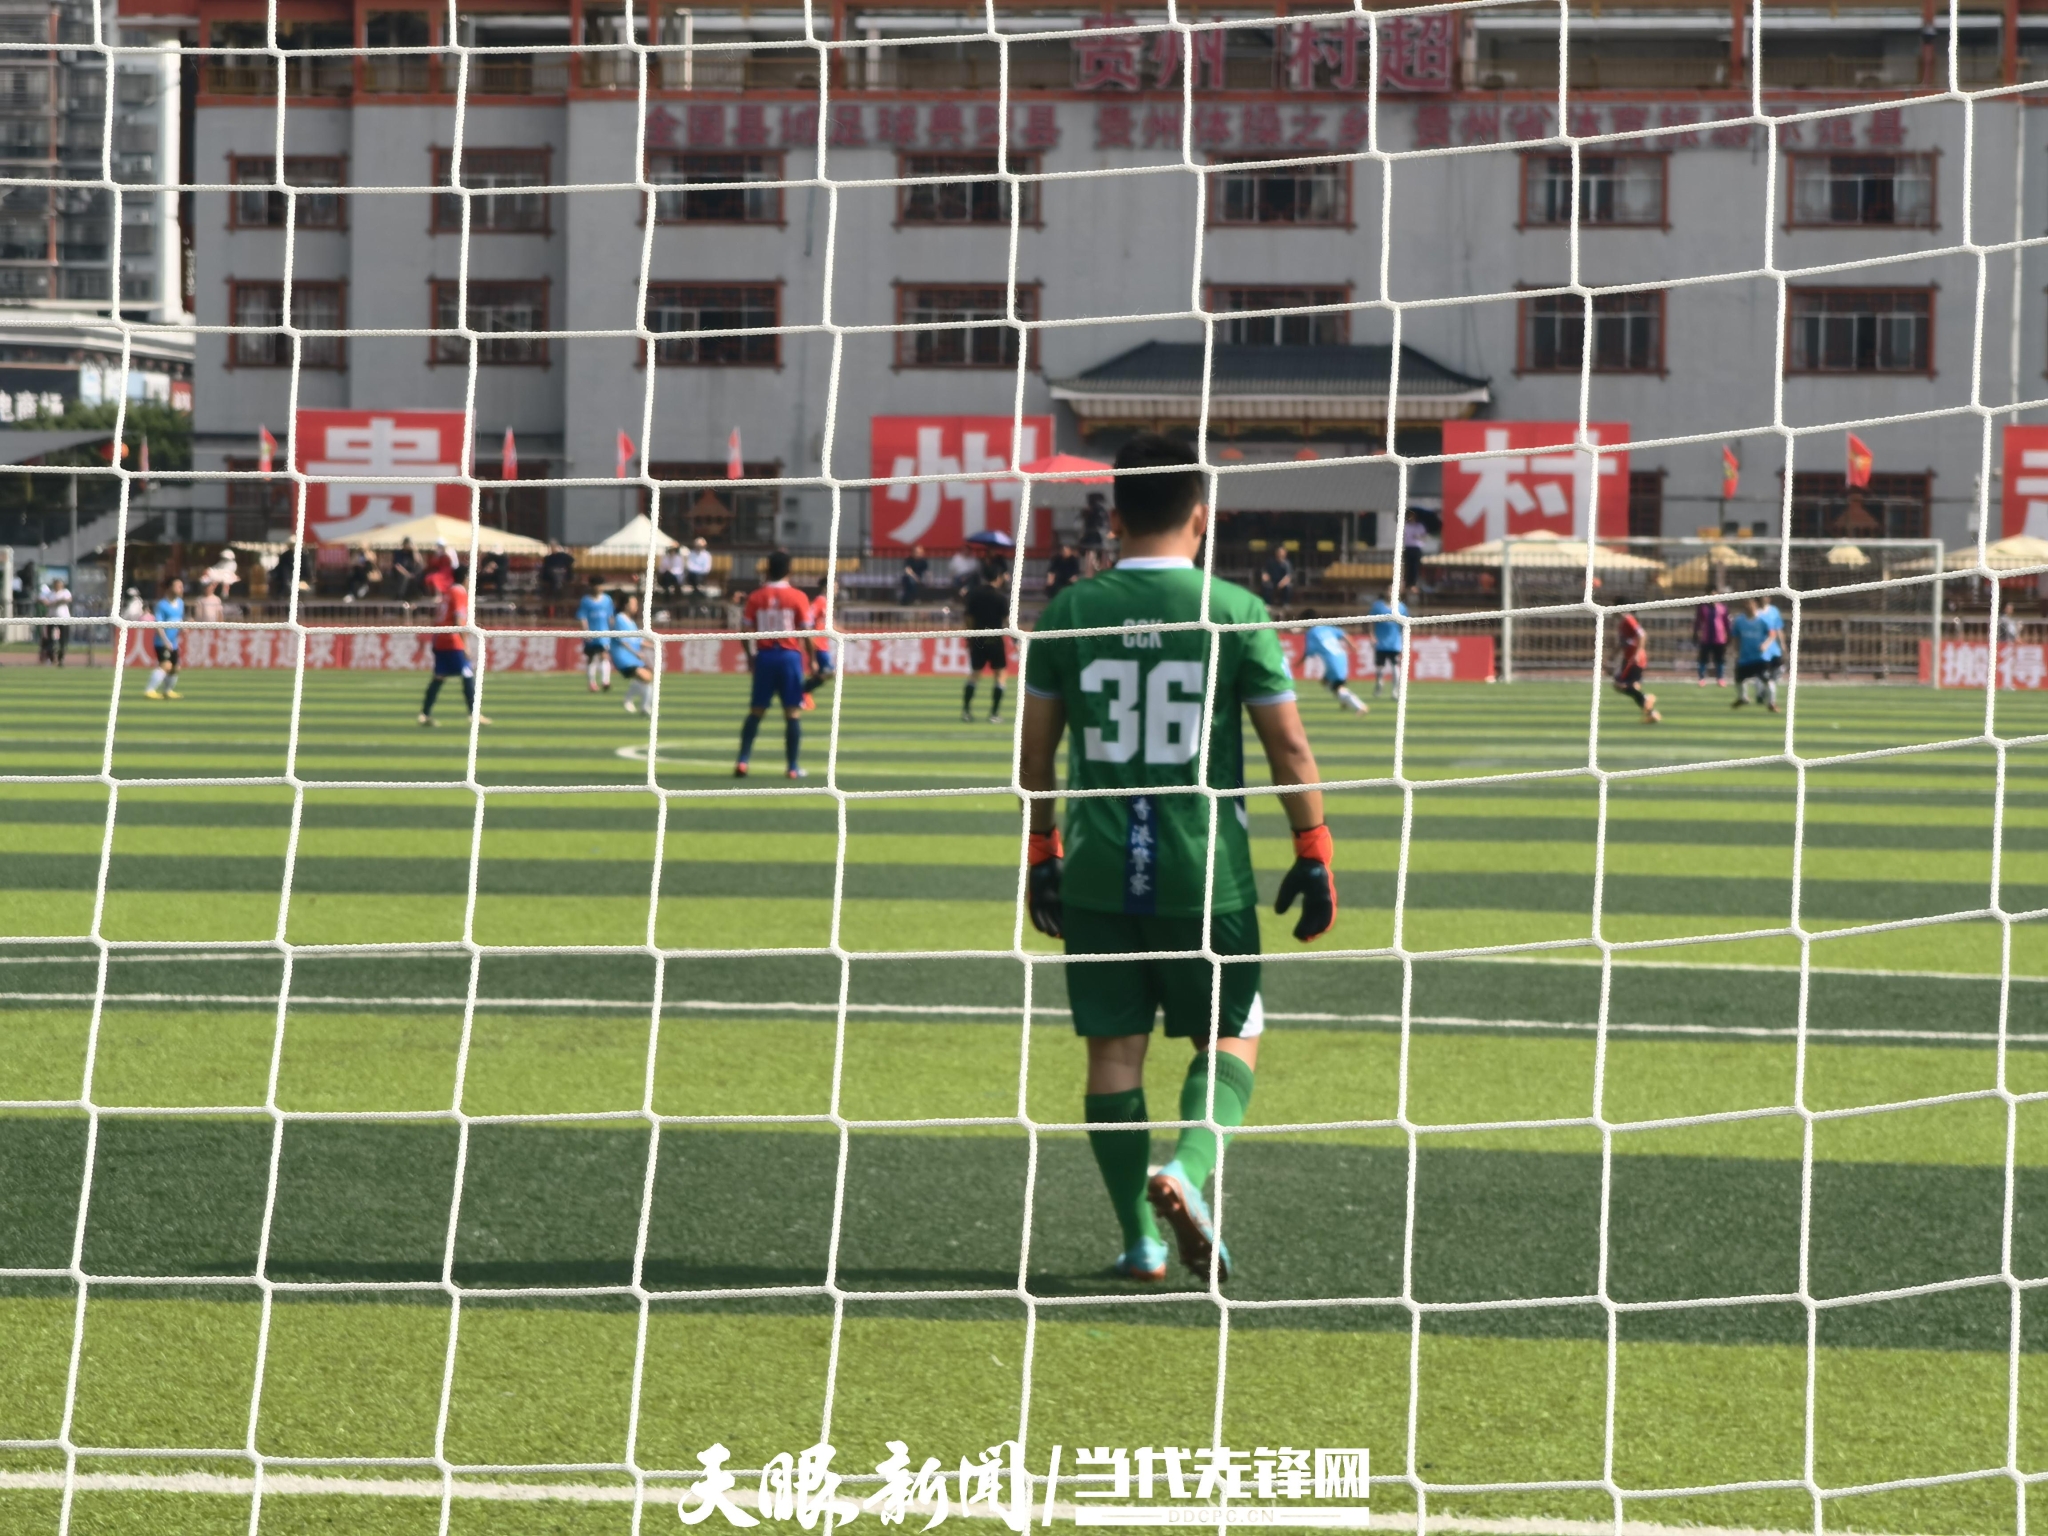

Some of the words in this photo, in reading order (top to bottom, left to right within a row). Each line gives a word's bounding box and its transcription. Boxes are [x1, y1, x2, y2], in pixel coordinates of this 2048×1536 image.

[1075, 15, 1226, 90] 贵州
[1287, 14, 1453, 91] 村超
[305, 417, 459, 541] 贵
[886, 426, 1038, 547] 州
[1454, 430, 1618, 544] 村
[125, 627, 335, 668] 人就该有追求
[351, 631, 557, 671] 热爱梦想
[1080, 659, 1204, 764] 36
